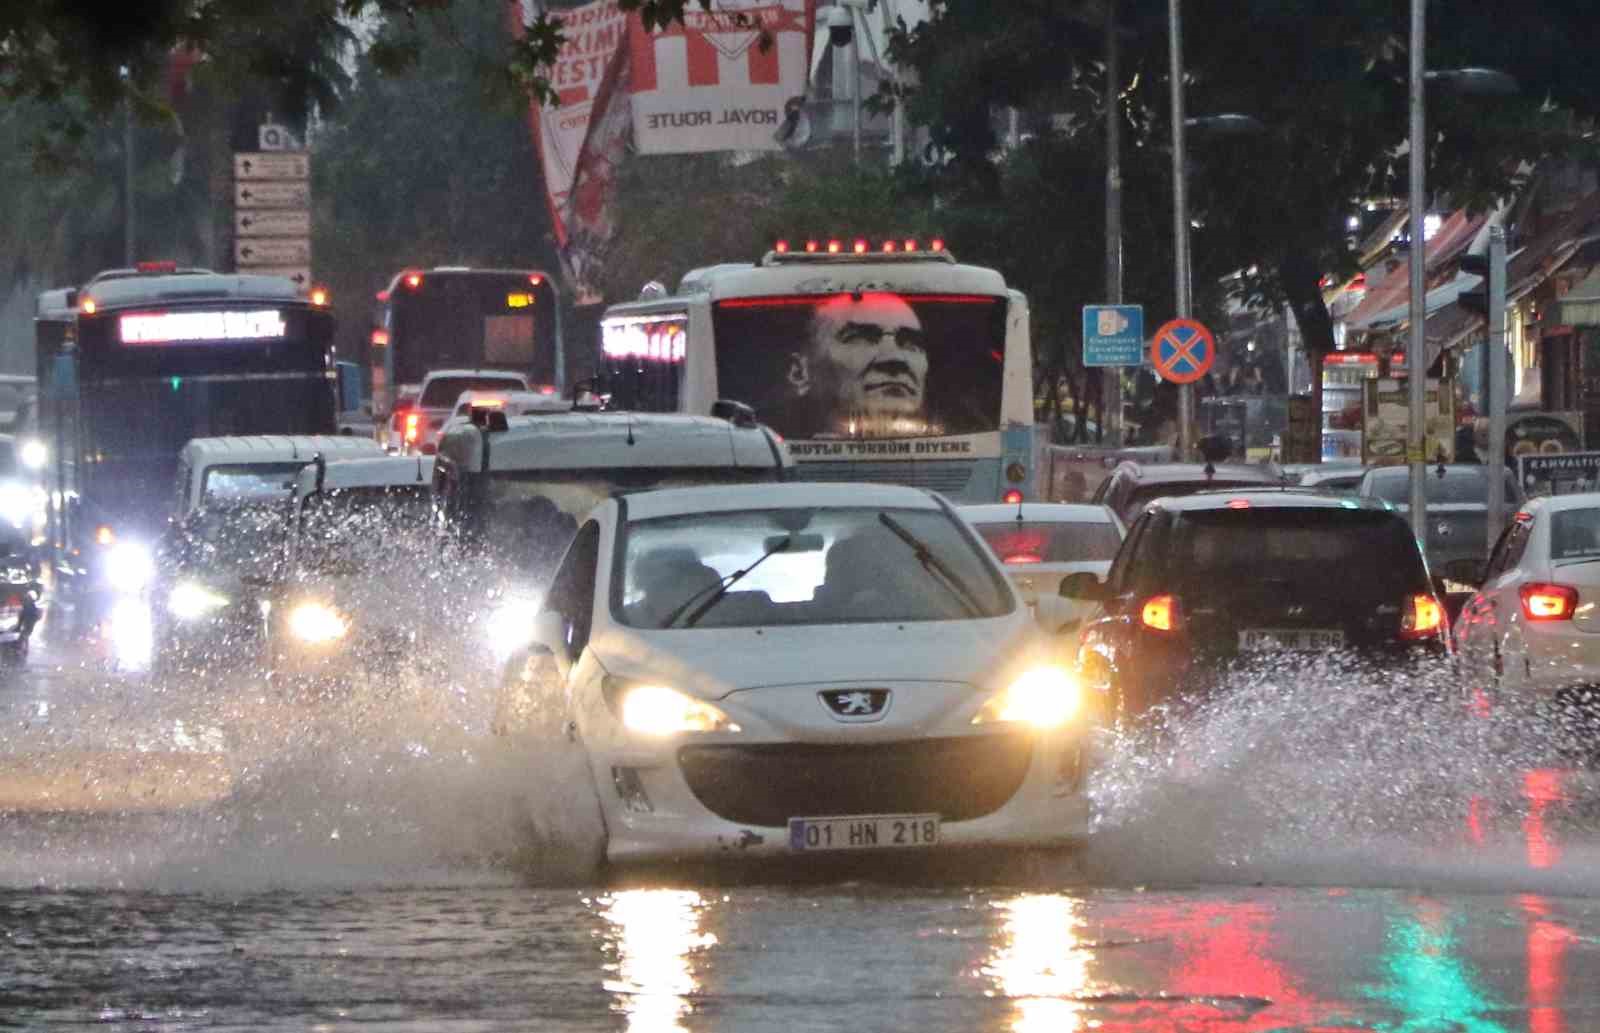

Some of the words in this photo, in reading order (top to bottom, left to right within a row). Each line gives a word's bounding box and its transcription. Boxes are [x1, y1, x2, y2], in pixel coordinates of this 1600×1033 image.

[789, 443, 843, 455] MUTLU
[807, 825, 833, 847] 01
[850, 823, 878, 845] HN
[893, 820, 937, 843] 218
